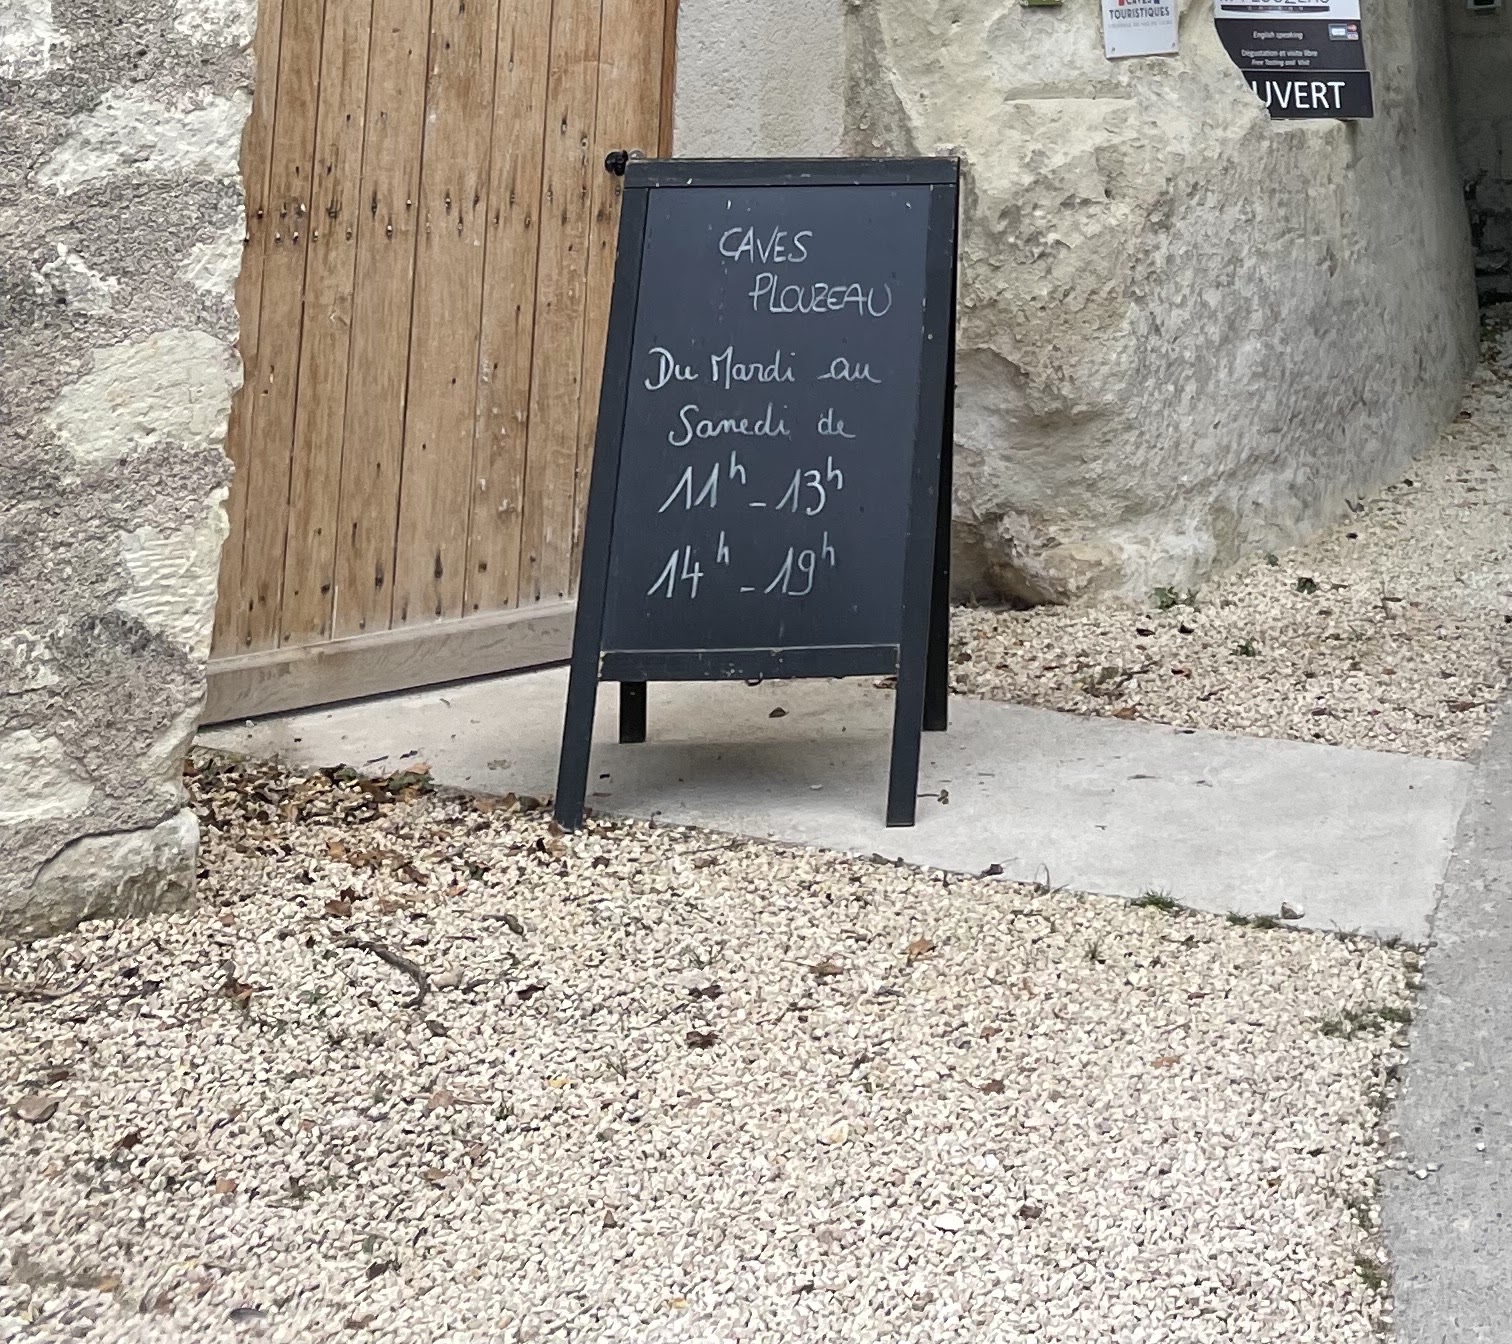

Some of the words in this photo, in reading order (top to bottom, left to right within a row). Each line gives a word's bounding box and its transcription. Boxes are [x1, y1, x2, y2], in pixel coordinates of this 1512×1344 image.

[1109, 6, 1170, 20] TOURISTIQUES
[1253, 30, 1275, 40] English
[1276, 31, 1304, 40] speaking
[1250, 80, 1346, 109] UVERT
[719, 225, 813, 264] CAVES
[748, 272, 893, 317] PLOUZEAU
[644, 346, 699, 391] Du
[710, 345, 796, 390] Mardi
[816, 407, 857, 439] de
